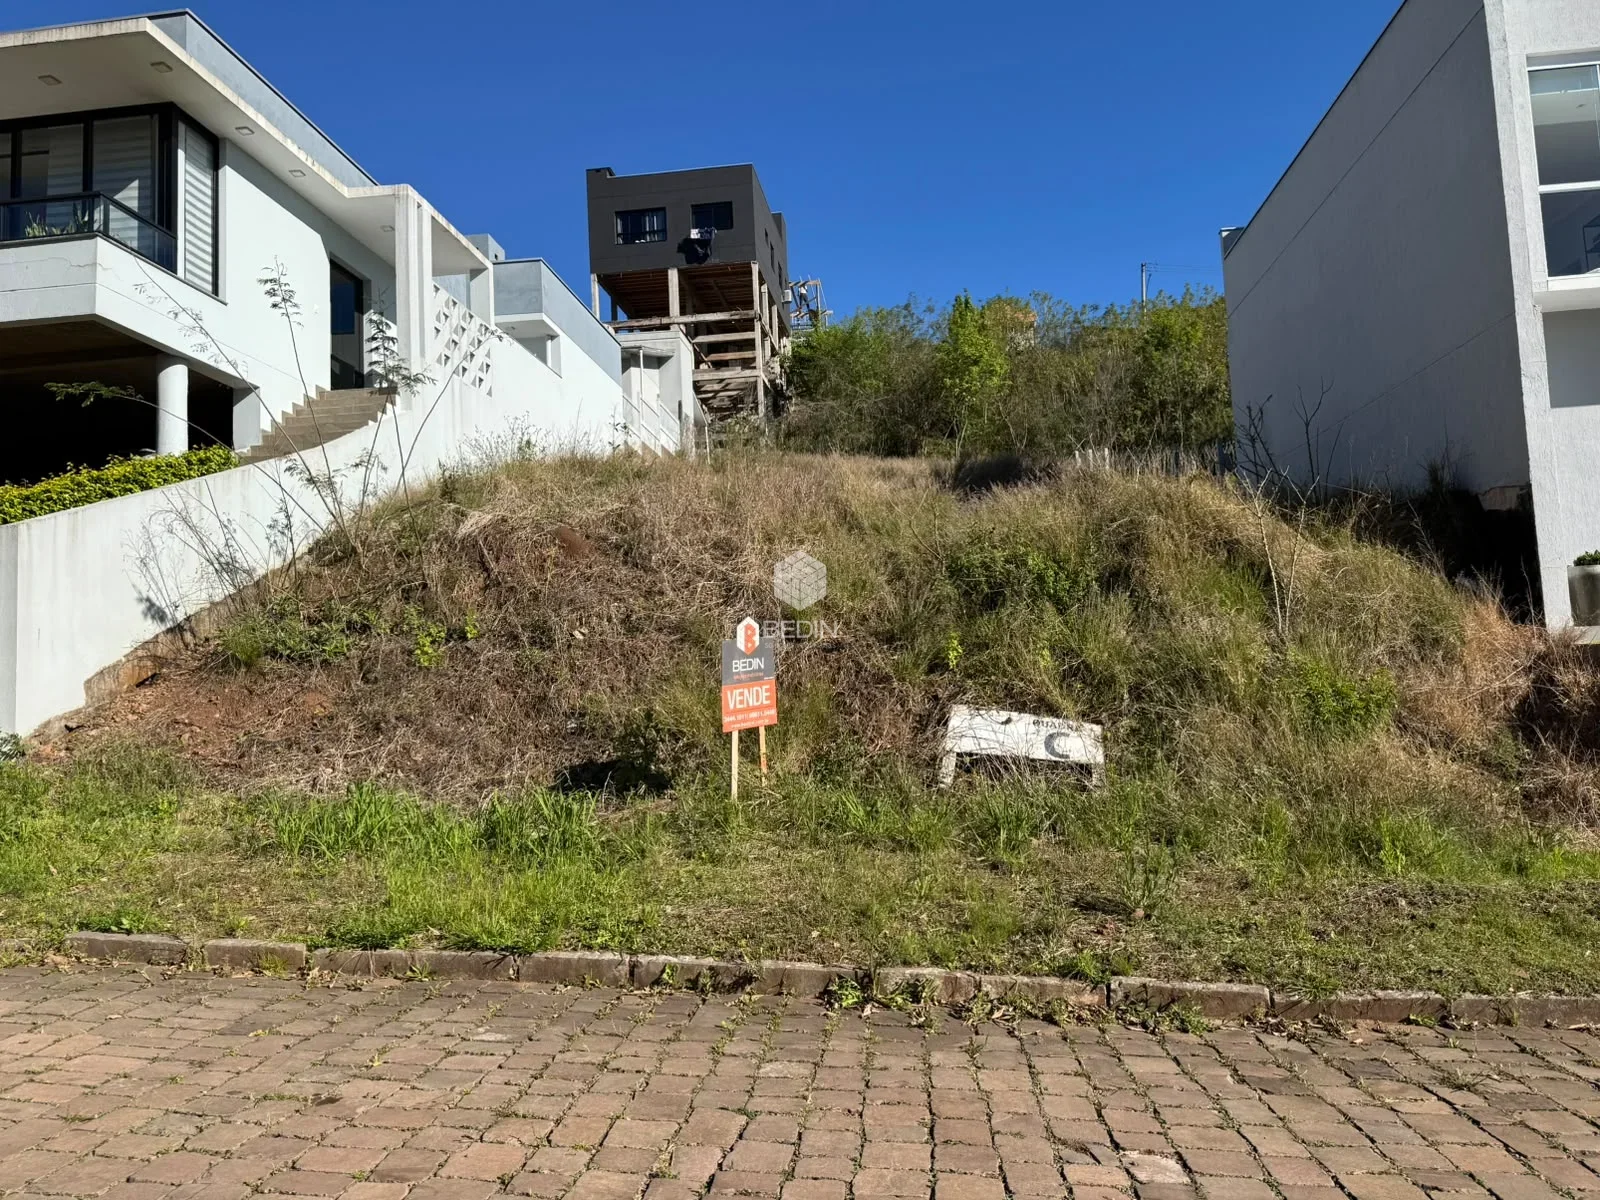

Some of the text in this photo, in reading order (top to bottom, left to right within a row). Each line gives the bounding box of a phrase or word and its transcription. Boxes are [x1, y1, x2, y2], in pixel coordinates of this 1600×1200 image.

[732, 657, 765, 672] BEDIN
[727, 685, 771, 710] VENDE
[1044, 731, 1070, 759] C
